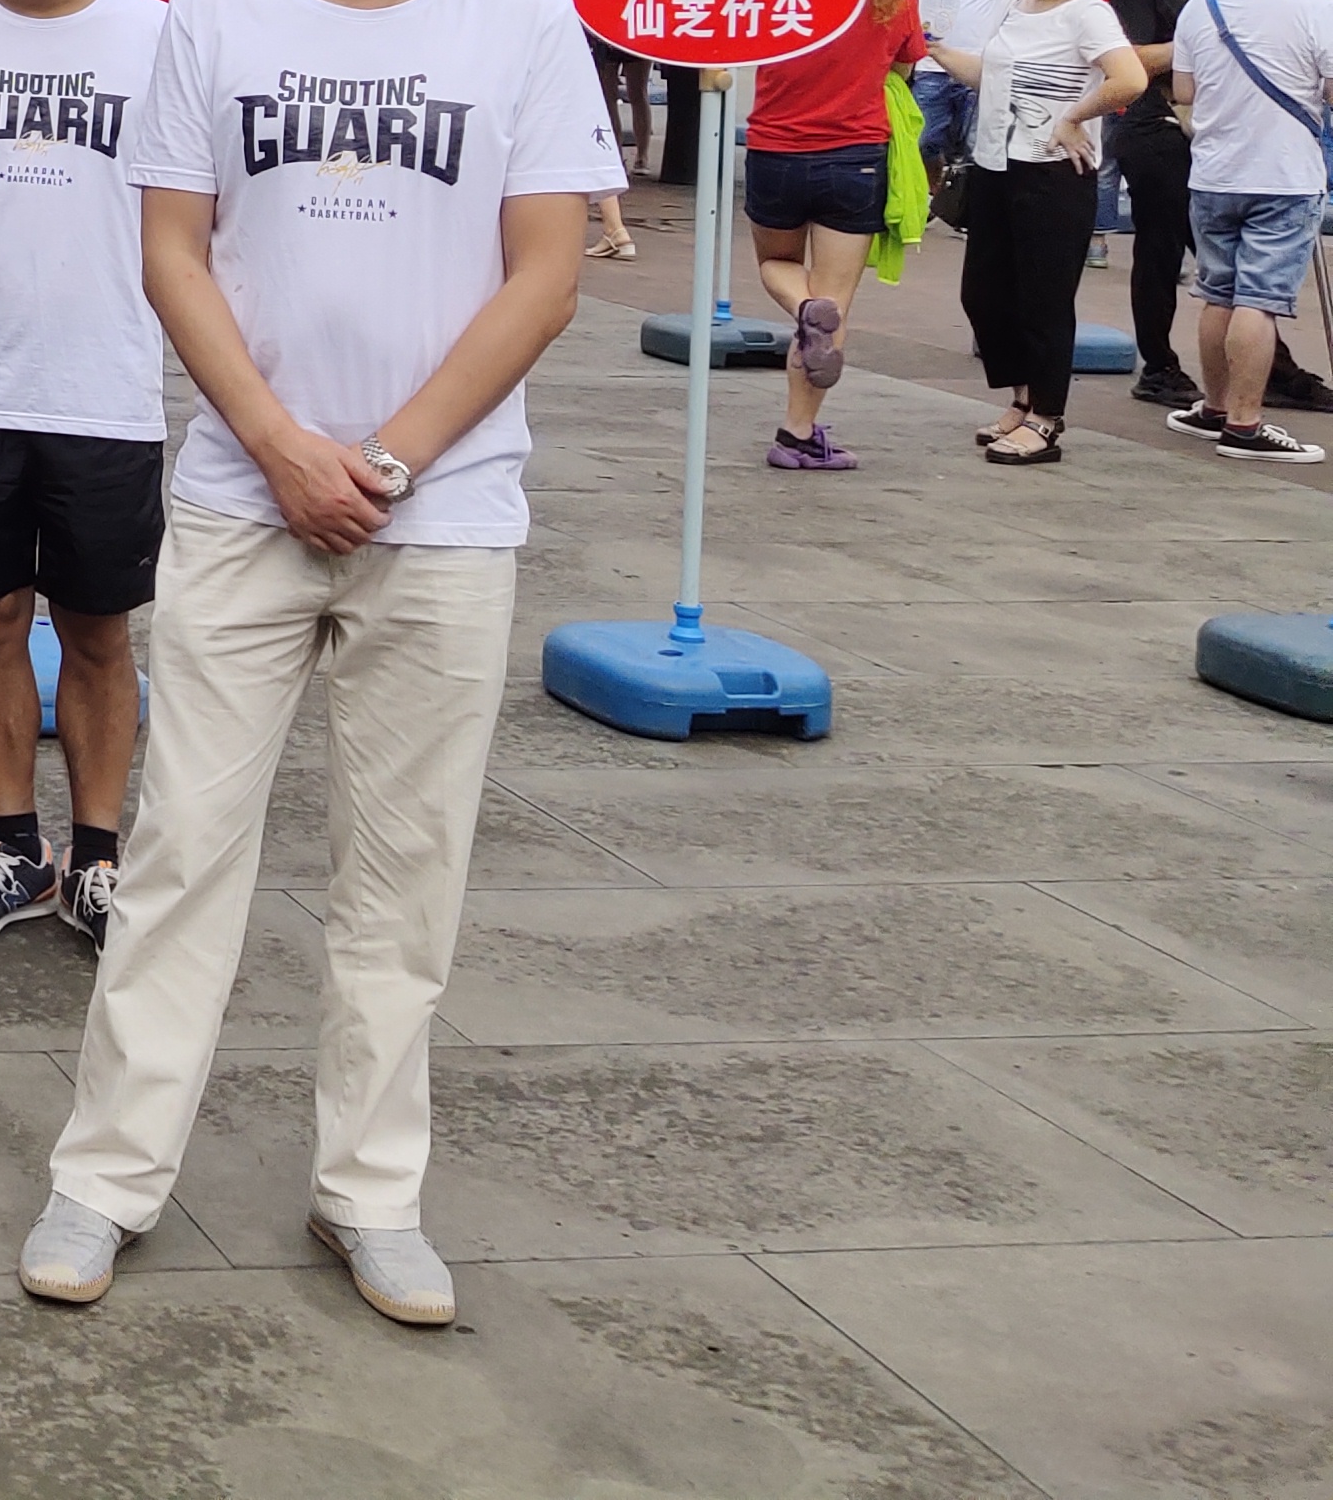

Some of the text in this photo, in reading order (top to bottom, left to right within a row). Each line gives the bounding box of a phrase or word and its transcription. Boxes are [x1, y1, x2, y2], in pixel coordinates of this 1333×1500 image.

[277, 69, 427, 106] SHOOTING
[233, 94, 476, 186] GUARD
[7, 175, 63, 186] BASKETBALL
[309, 208, 384, 222] BASKETBALL
